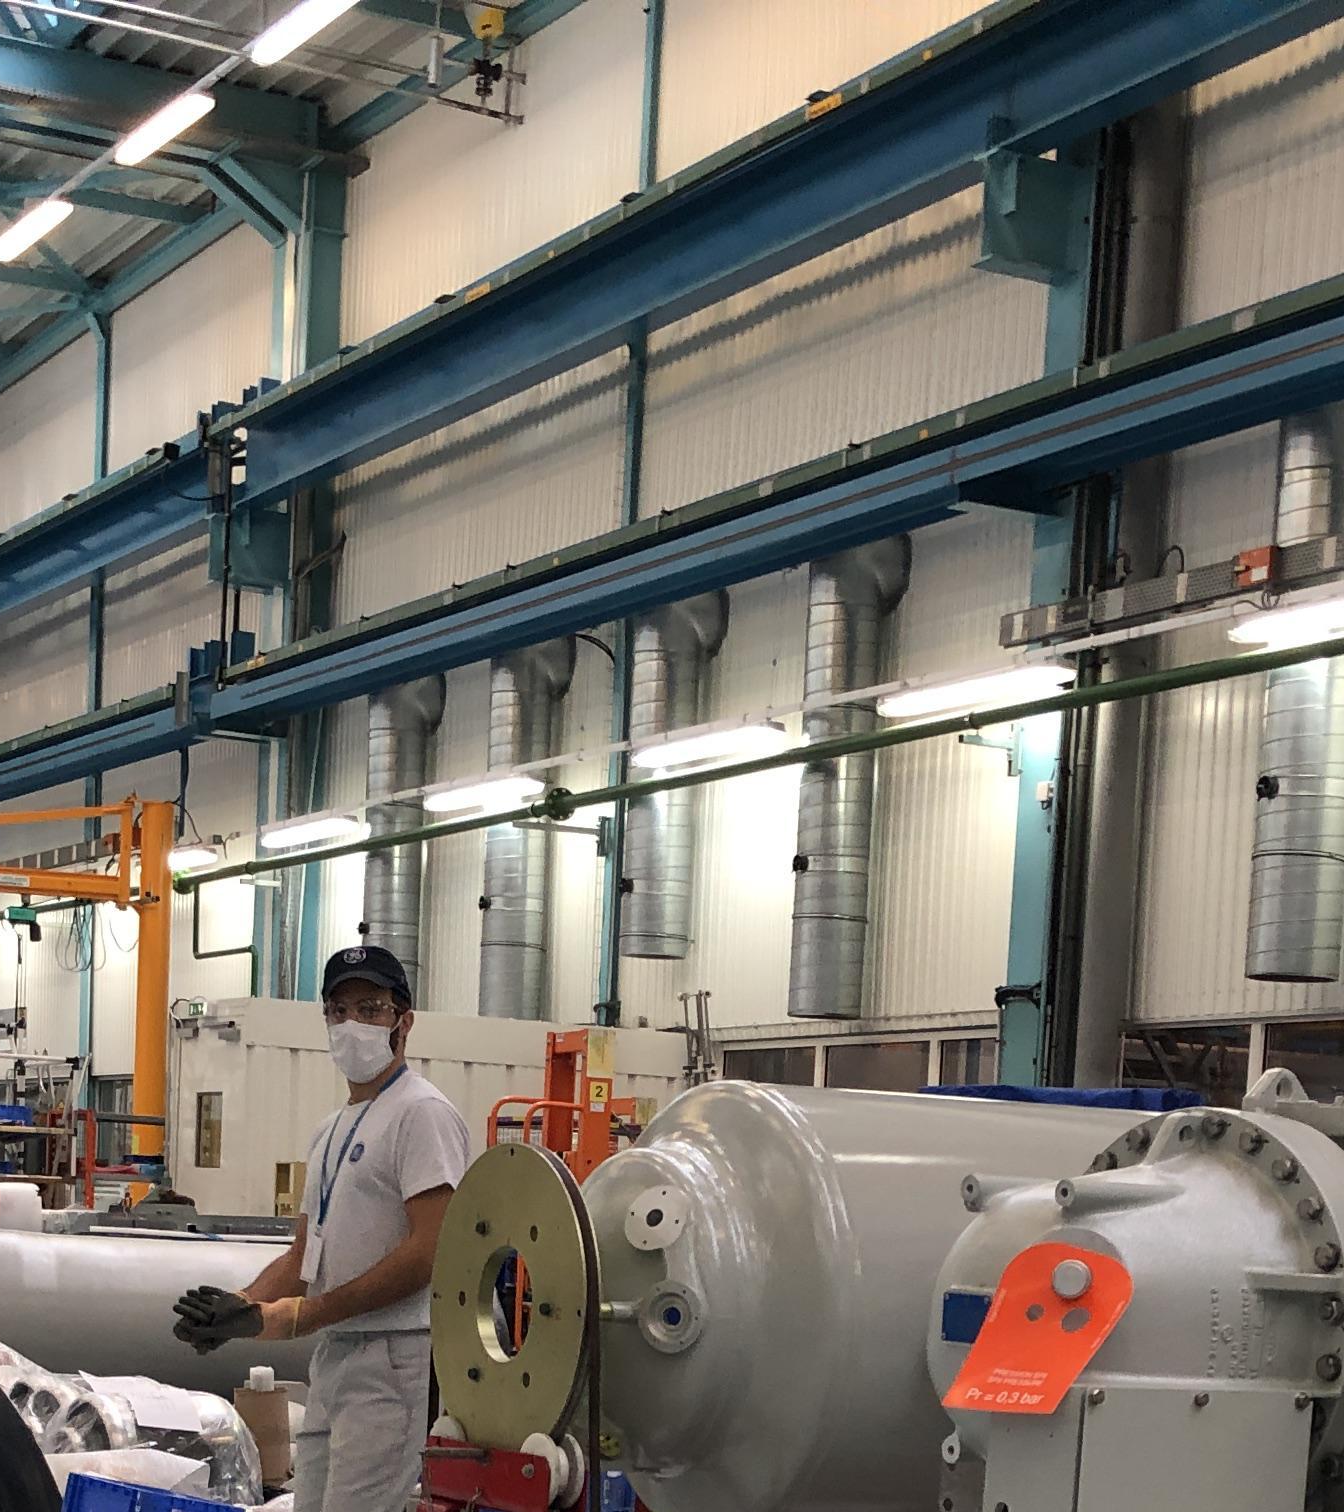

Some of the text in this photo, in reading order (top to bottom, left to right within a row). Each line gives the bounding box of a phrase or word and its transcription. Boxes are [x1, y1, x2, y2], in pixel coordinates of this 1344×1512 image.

[595, 1085, 604, 1098] 2
[965, 1387, 983, 1401] Pr
[995, 1391, 1019, 1405] 0,3
[1020, 1391, 1046, 1405] bar
